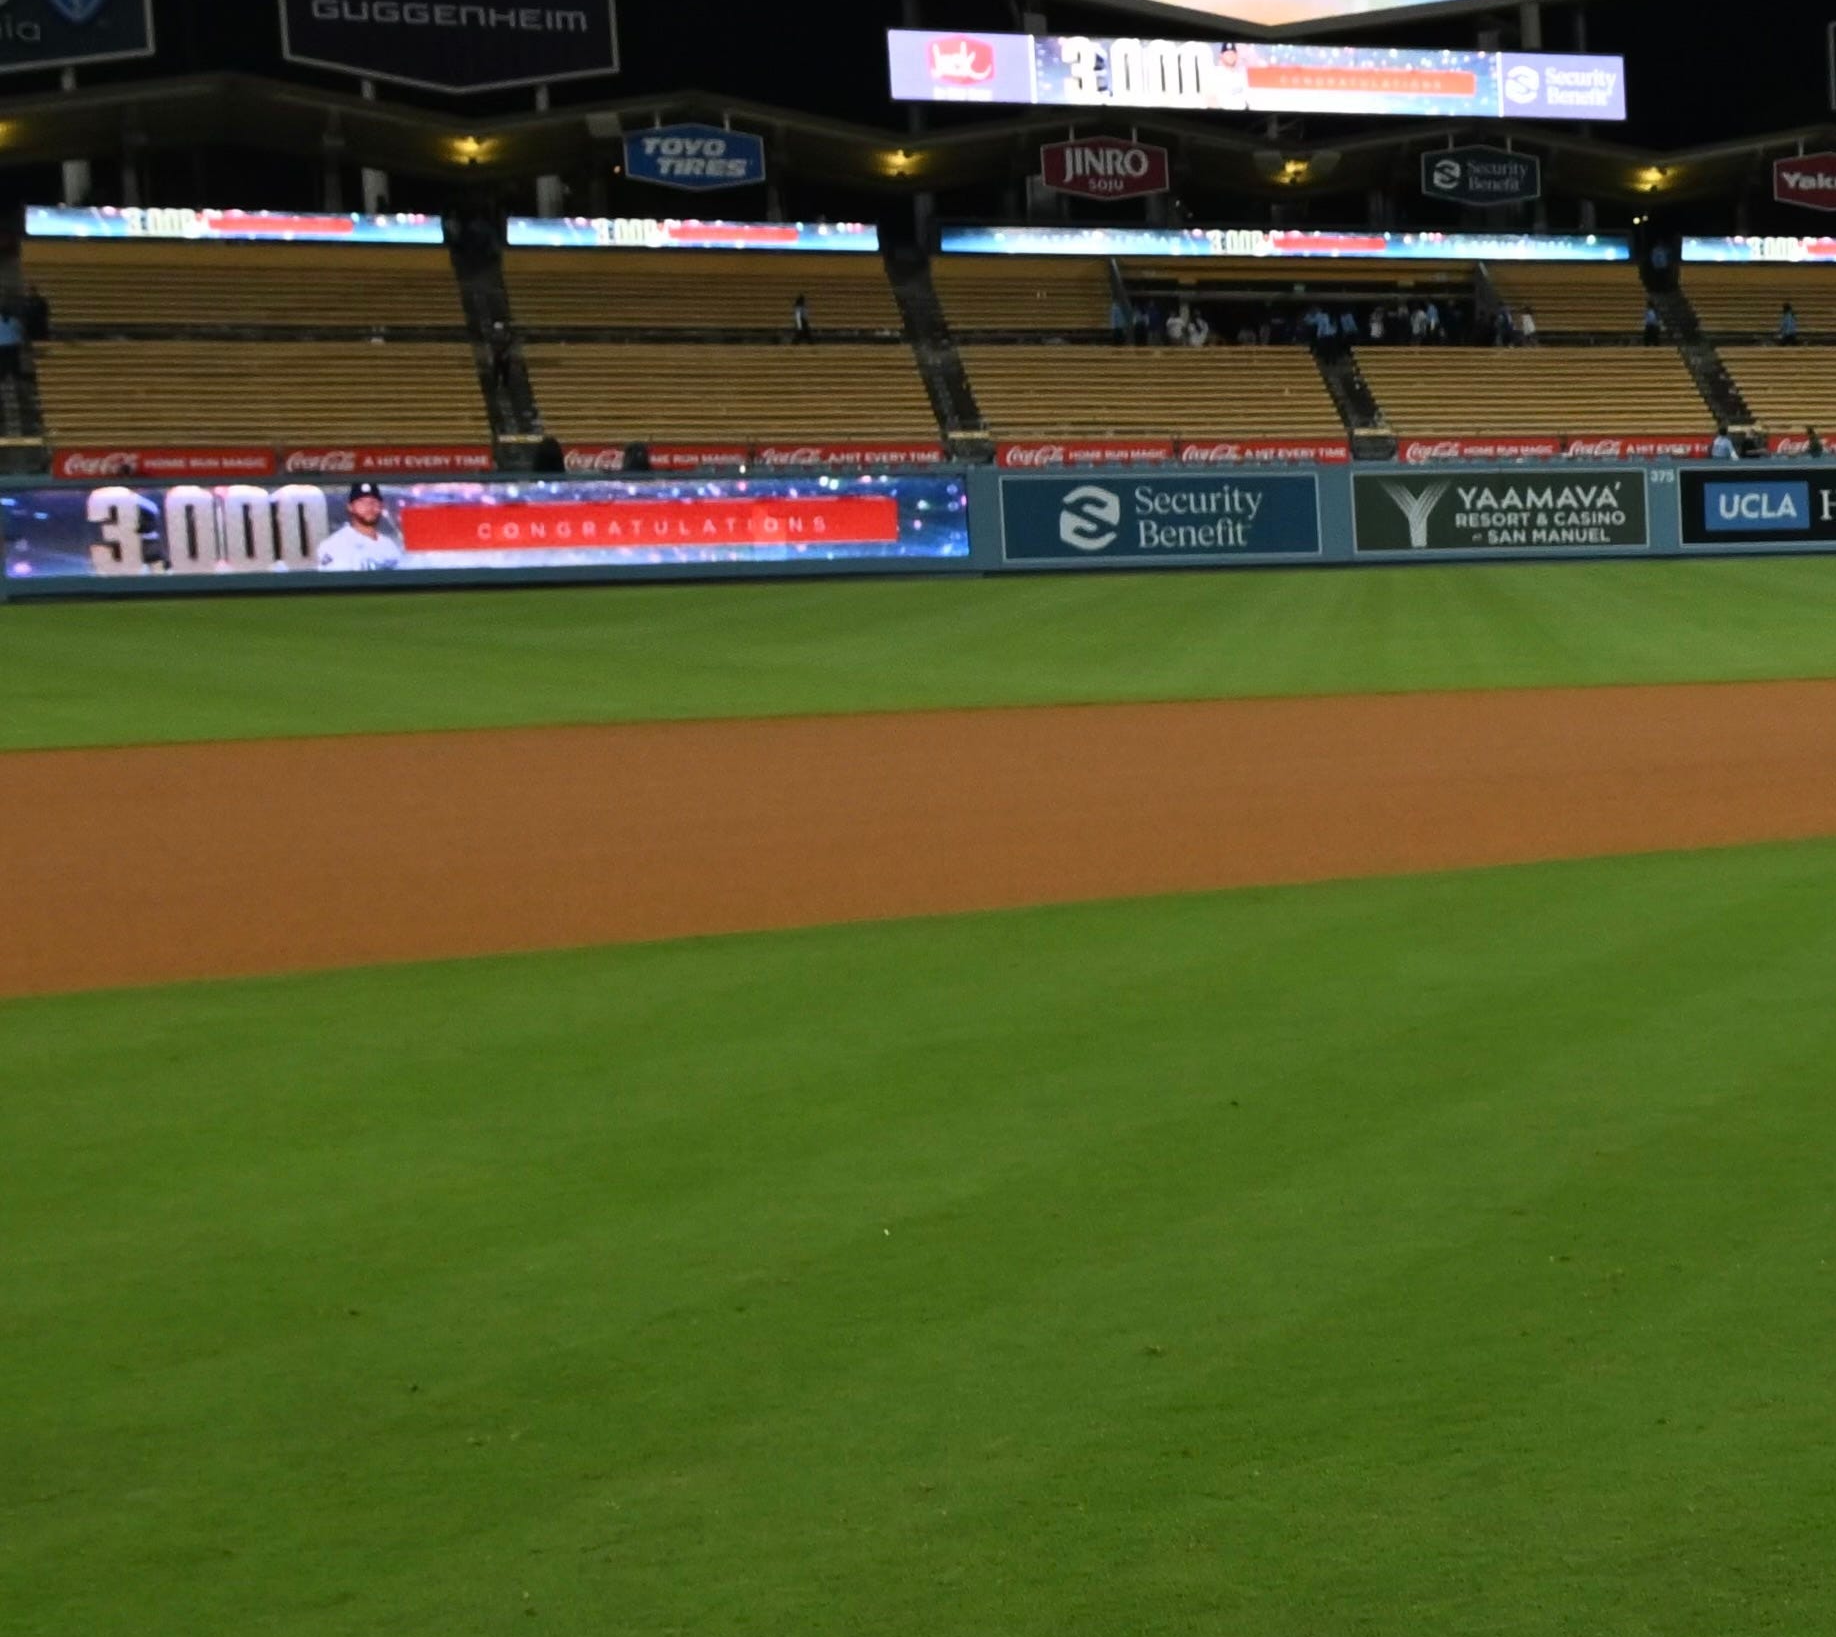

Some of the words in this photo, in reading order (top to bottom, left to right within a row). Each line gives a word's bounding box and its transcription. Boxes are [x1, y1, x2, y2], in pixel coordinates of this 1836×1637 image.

[1544, 66, 1616, 98] Security
[642, 137, 727, 156] TOYO
[657, 157, 747, 177] TIRES
[1064, 147, 1149, 183] JINRO
[1088, 178, 1125, 192] SOJU
[1134, 484, 1263, 519] Security
[1718, 493, 1798, 520] UCLA
[477, 516, 827, 541] CONGRATULATIONS
[1455, 511, 1531, 529] RESORT
[1536, 512, 1548, 527] &
[1554, 510, 1626, 527] CASINO
[1138, 517, 1249, 549] Benefit
[1487, 529, 1528, 545] SAN
[1532, 527, 1611, 544] MANUEL
